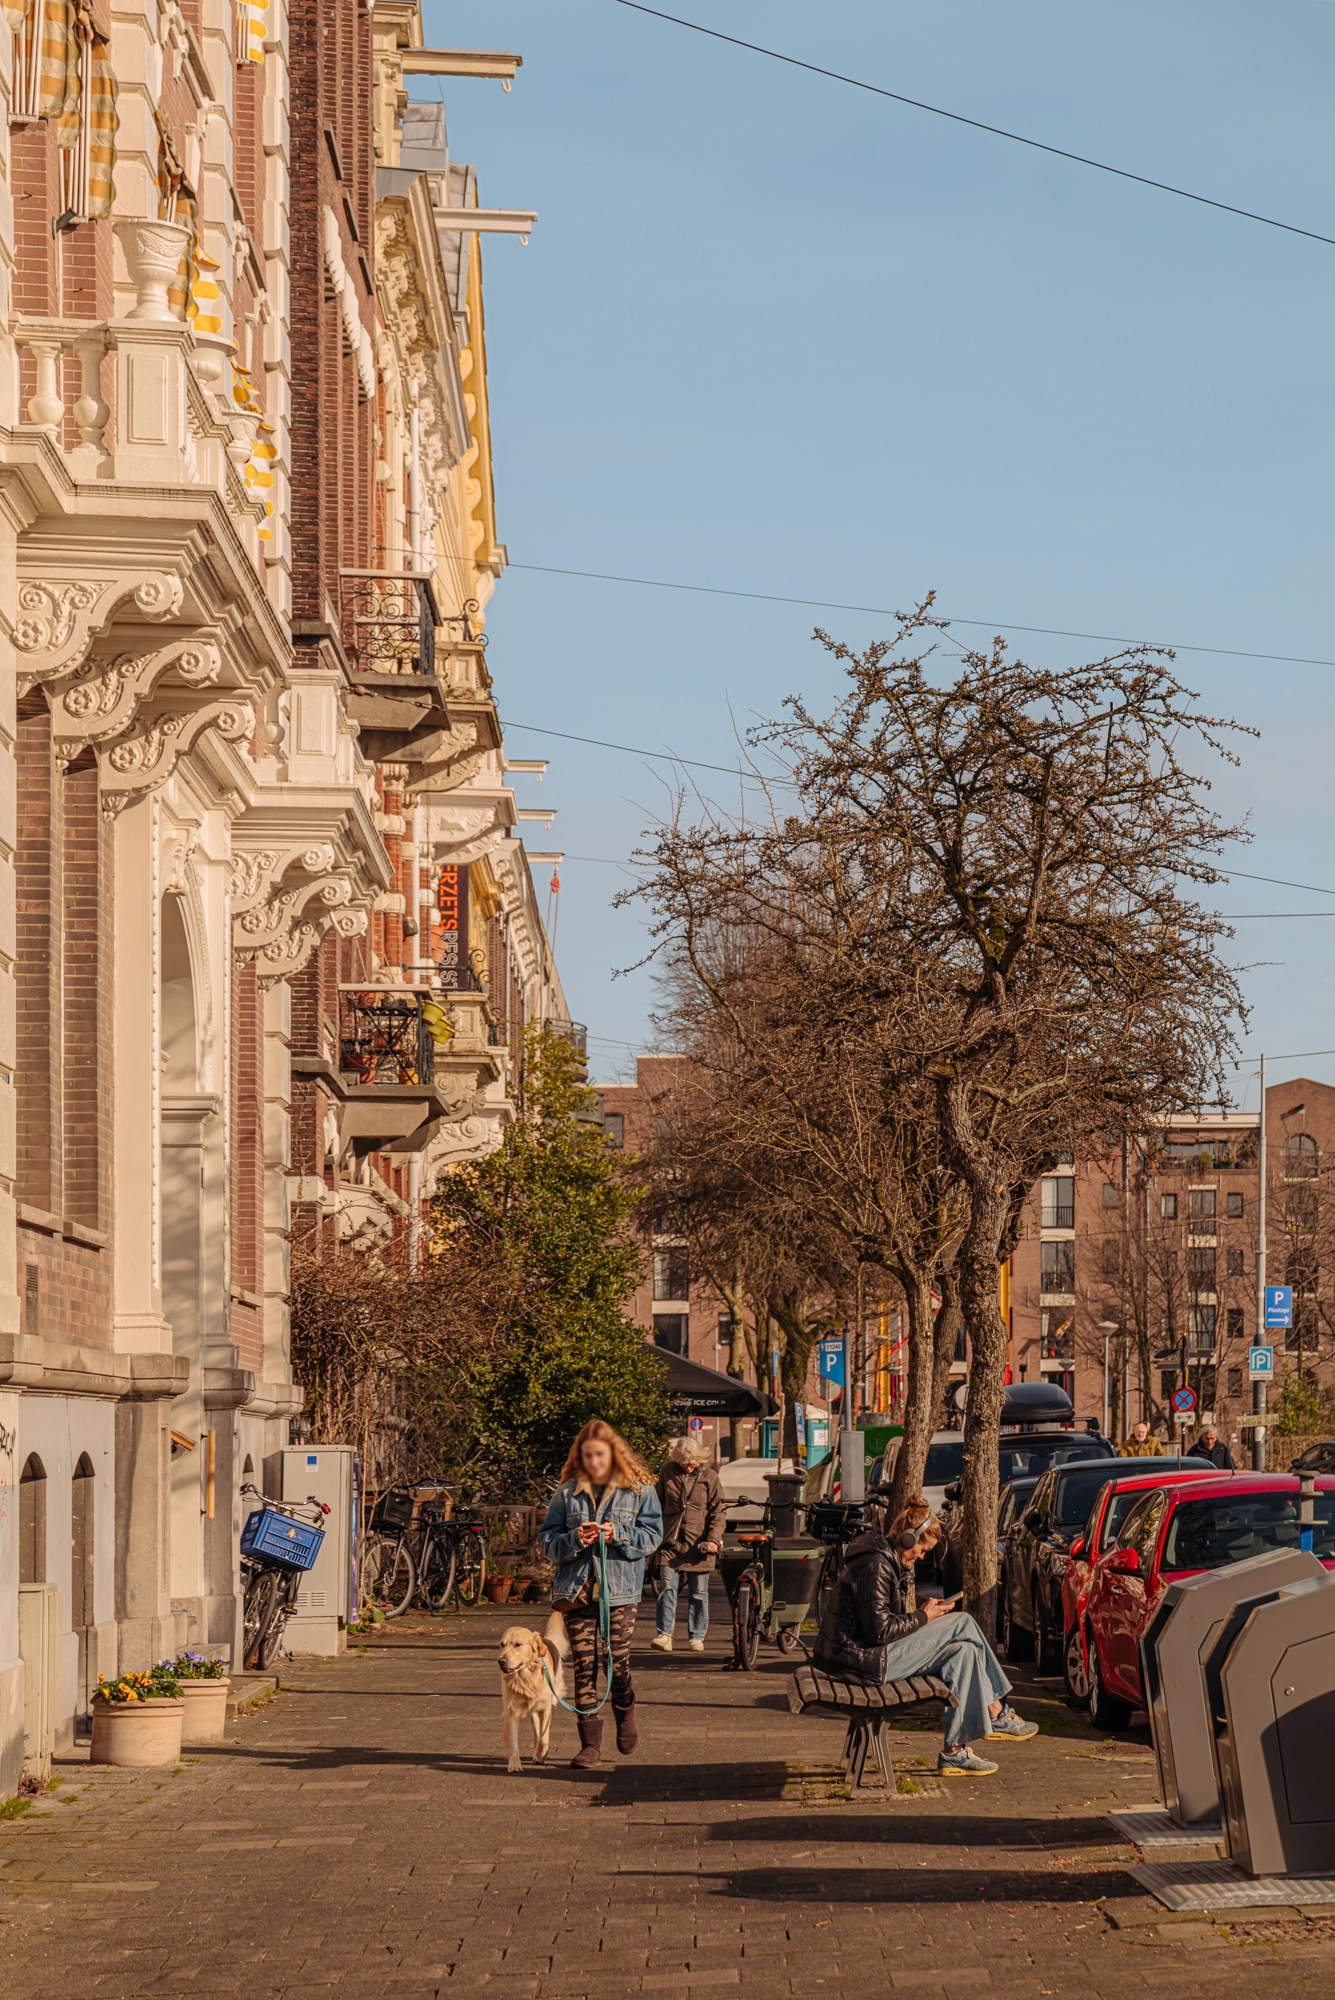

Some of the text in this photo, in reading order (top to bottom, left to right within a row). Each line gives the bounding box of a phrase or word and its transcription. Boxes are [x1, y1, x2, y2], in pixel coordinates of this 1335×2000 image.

[1274, 1291, 1284, 1305] P
[826, 1353, 837, 1372] P
[1256, 1355, 1267, 1369] P
